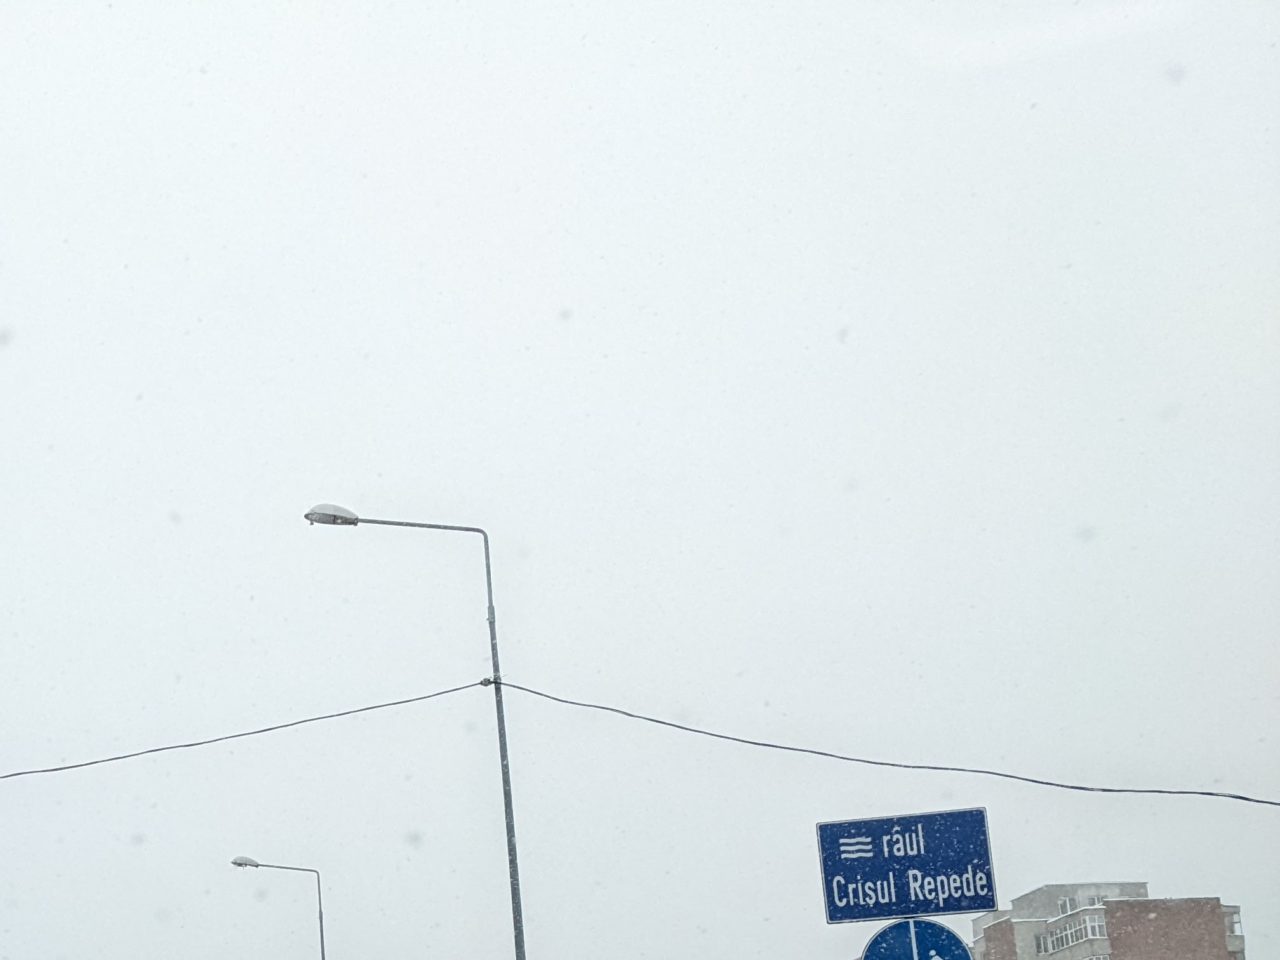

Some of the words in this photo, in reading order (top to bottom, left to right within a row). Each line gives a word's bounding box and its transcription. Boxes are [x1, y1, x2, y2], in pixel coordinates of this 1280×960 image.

[882, 823, 925, 858] râul
[832, 872, 897, 908] Crișul
[907, 865, 989, 907] Repede
